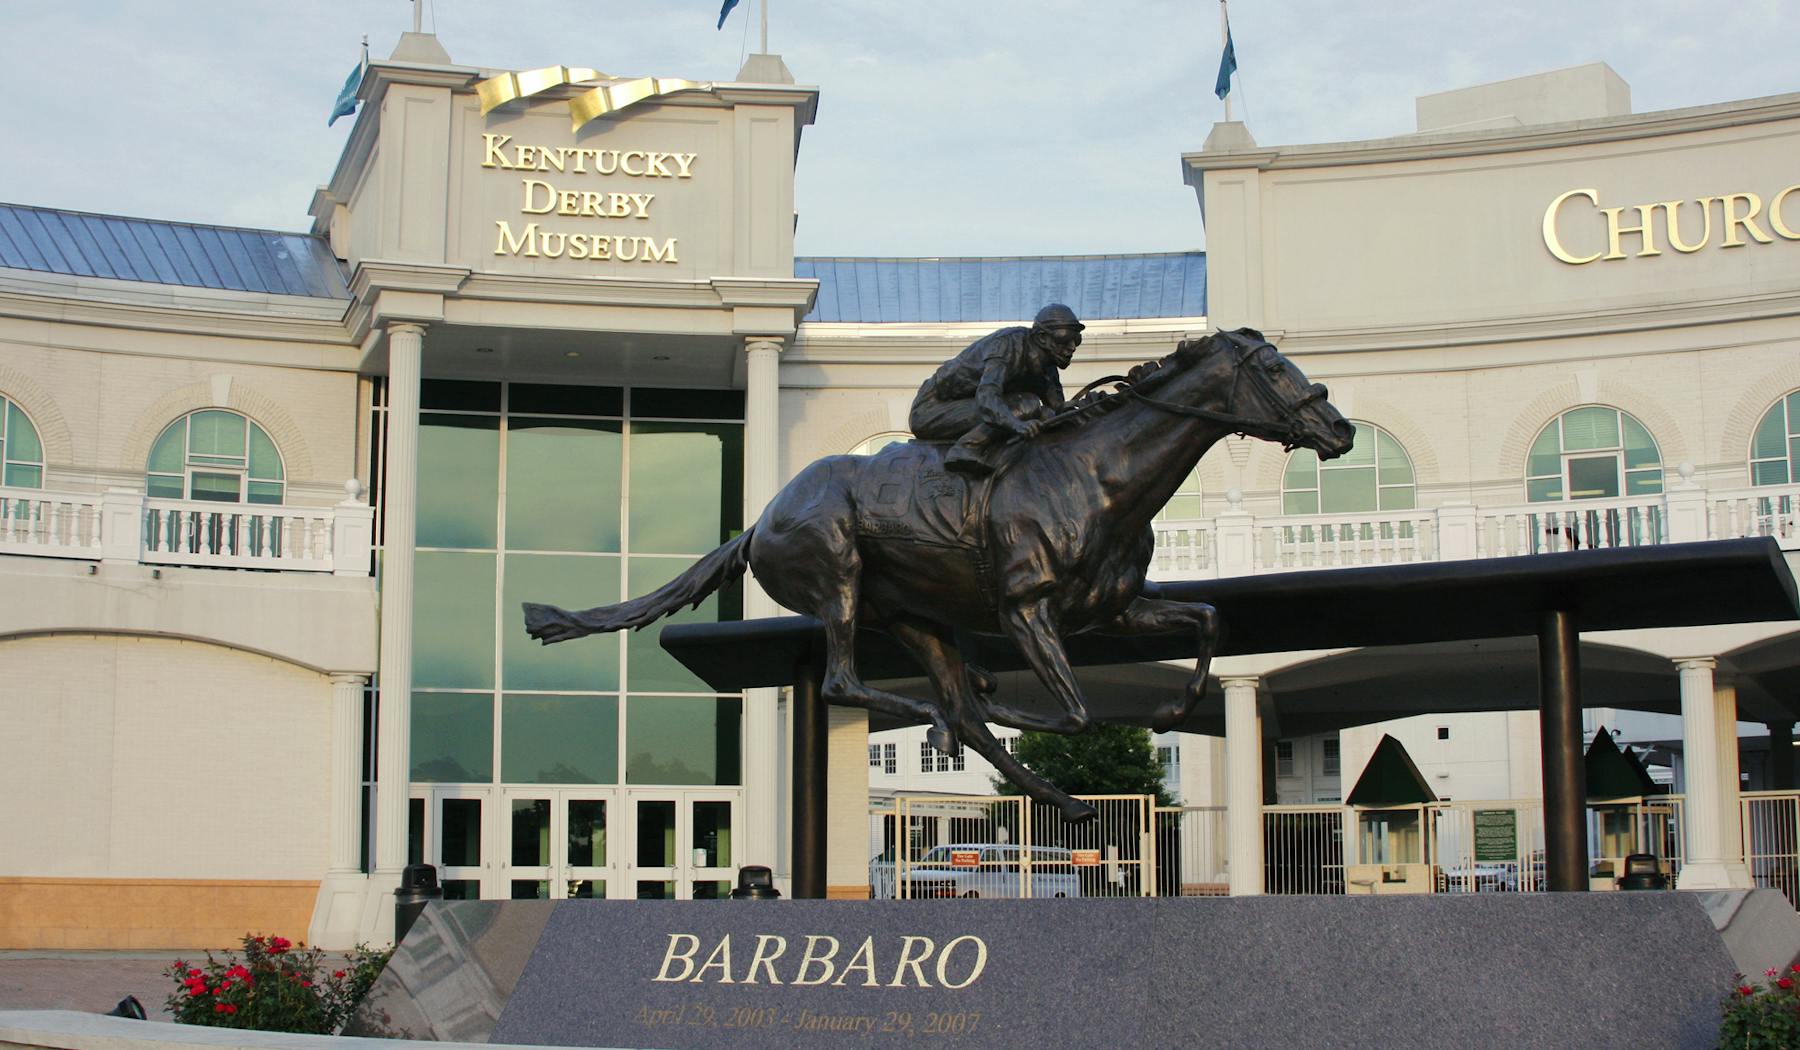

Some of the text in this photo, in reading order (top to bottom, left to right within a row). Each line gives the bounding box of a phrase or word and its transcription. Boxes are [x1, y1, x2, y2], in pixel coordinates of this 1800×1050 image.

[481, 133, 698, 179] KENTUCKY
[521, 178, 655, 219] DERBY
[494, 220, 678, 263] MUSEUM
[651, 933, 988, 989] BARBARO
[634, 1004, 683, 1027] April
[723, 1007, 777, 1028] 2003
[793, 1008, 877, 1034] January
[882, 1011, 915, 1037] 29,
[923, 1011, 983, 1035] 2007
